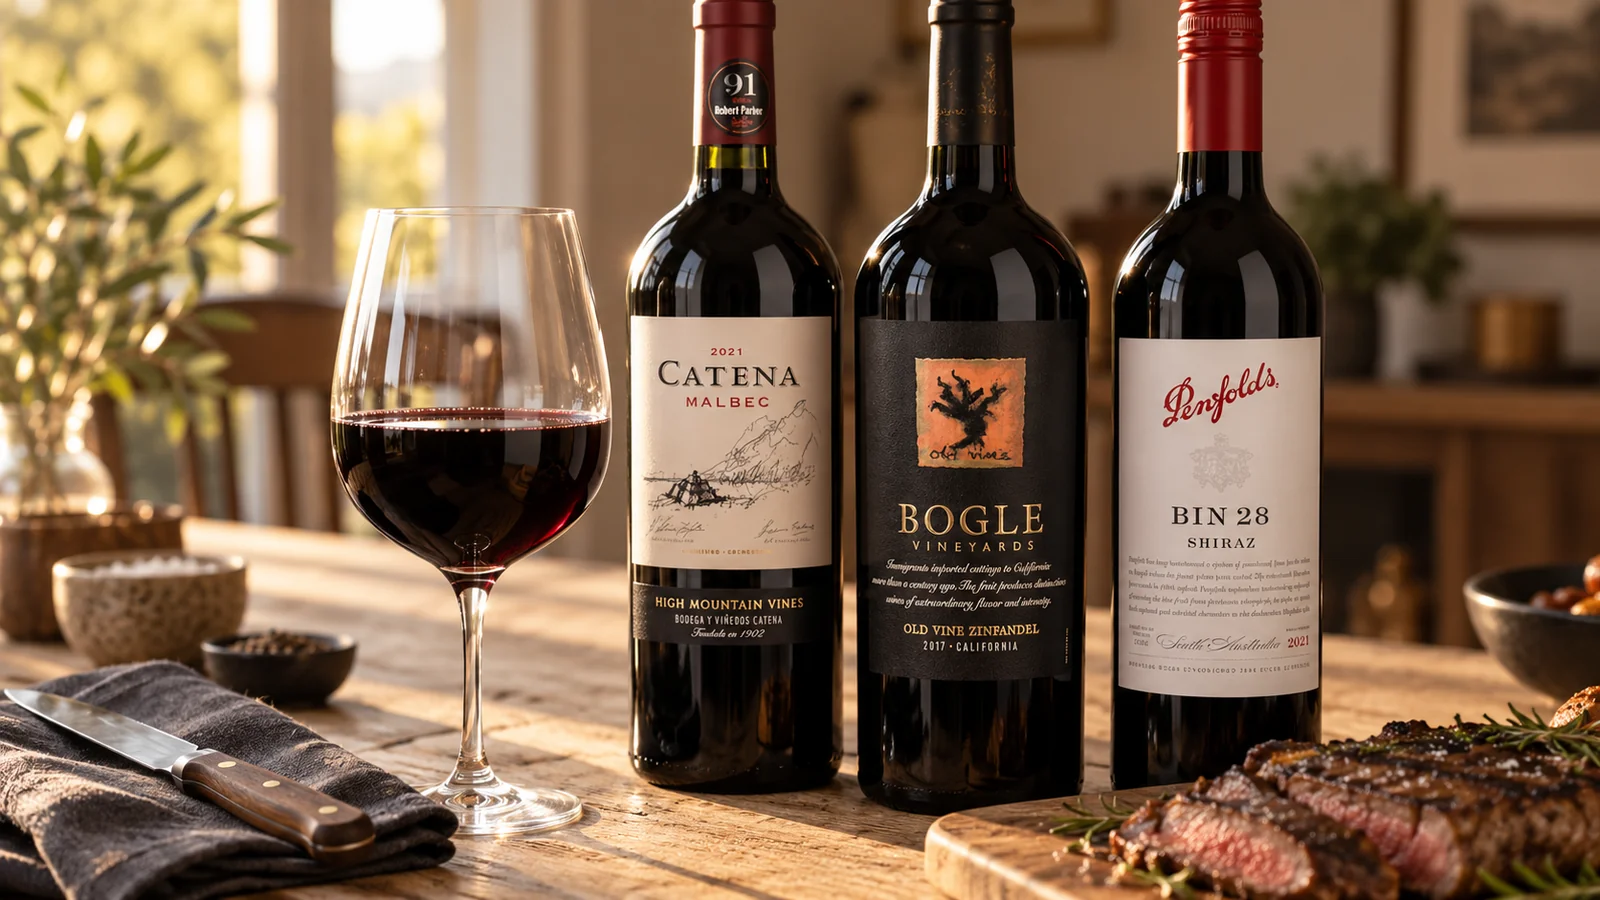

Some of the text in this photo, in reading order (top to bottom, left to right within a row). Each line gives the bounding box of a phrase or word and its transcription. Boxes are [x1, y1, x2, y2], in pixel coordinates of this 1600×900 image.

[723, 73, 756, 96] 91
[714, 105, 763, 115] Robert Parker
[710, 347, 743, 356] 2021
[1162, 362, 1276, 428] Penfolds
[685, 396, 770, 408] MALBEC
[898, 503, 1044, 536] BOGLE
[1171, 506, 1269, 526] BIN 28
[912, 540, 1034, 552] VINEYARDS
[1187, 537, 1256, 549] SHIRAZ
[1003, 565, 1012, 573] to
[655, 596, 804, 610] HIGH MOUNTAIN VINES
[675, 614, 783, 626] BODEGA Y VIÑEDOS CATENA
[740, 628, 766, 638] 1902
[903, 623, 1040, 636] OLD VINE ZINFANDEL
[923, 641, 1018, 652] 2017 CALIFORNIA
[1287, 635, 1310, 648] 2021
